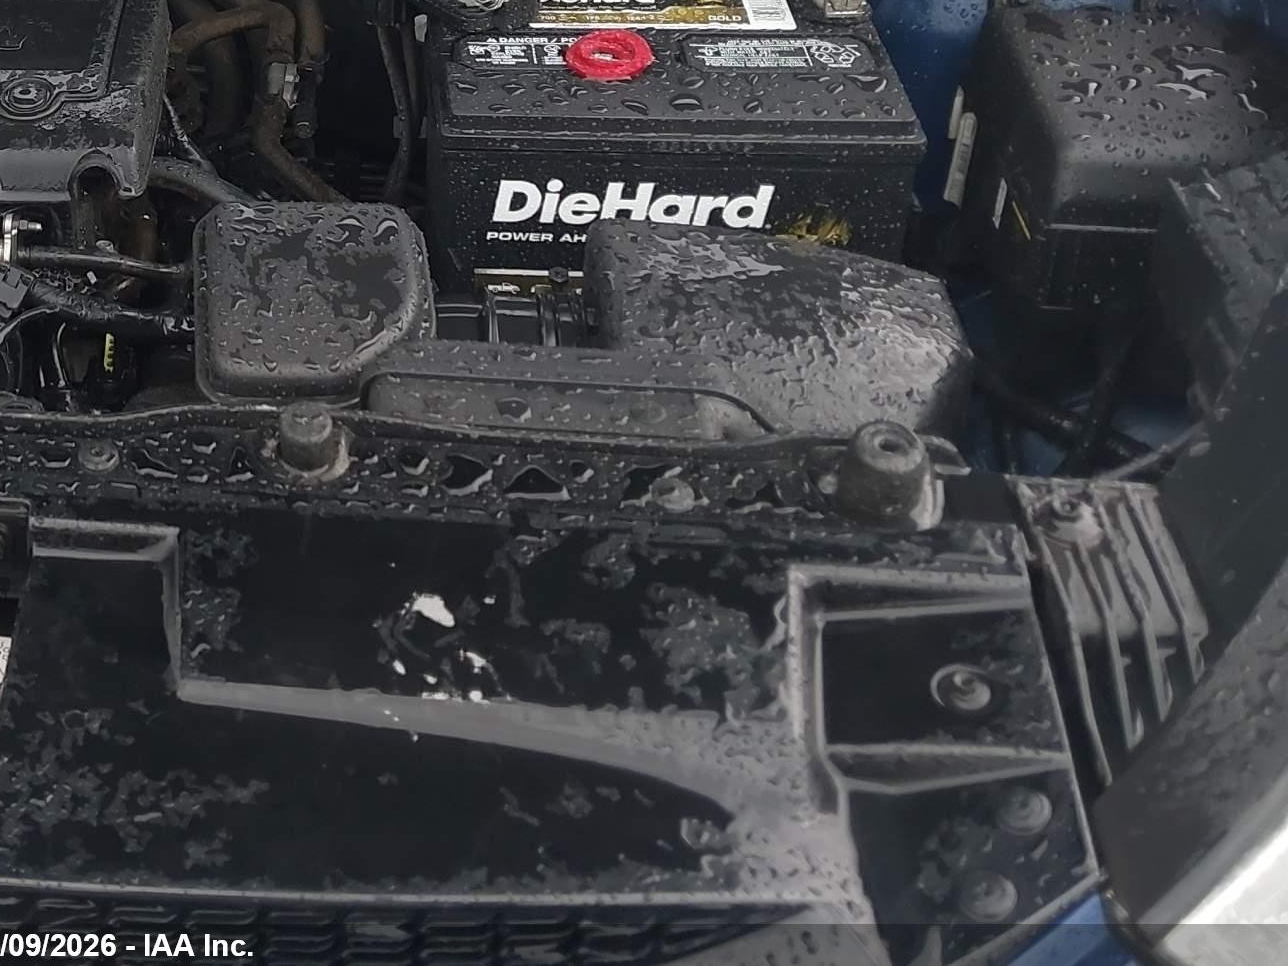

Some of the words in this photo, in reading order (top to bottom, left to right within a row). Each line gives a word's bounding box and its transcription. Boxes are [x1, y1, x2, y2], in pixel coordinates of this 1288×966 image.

[708, 14, 742, 22] GOLD
[492, 179, 776, 228] DieHard
[486, 231, 554, 243] POWER
[559, 233, 588, 243] AH
